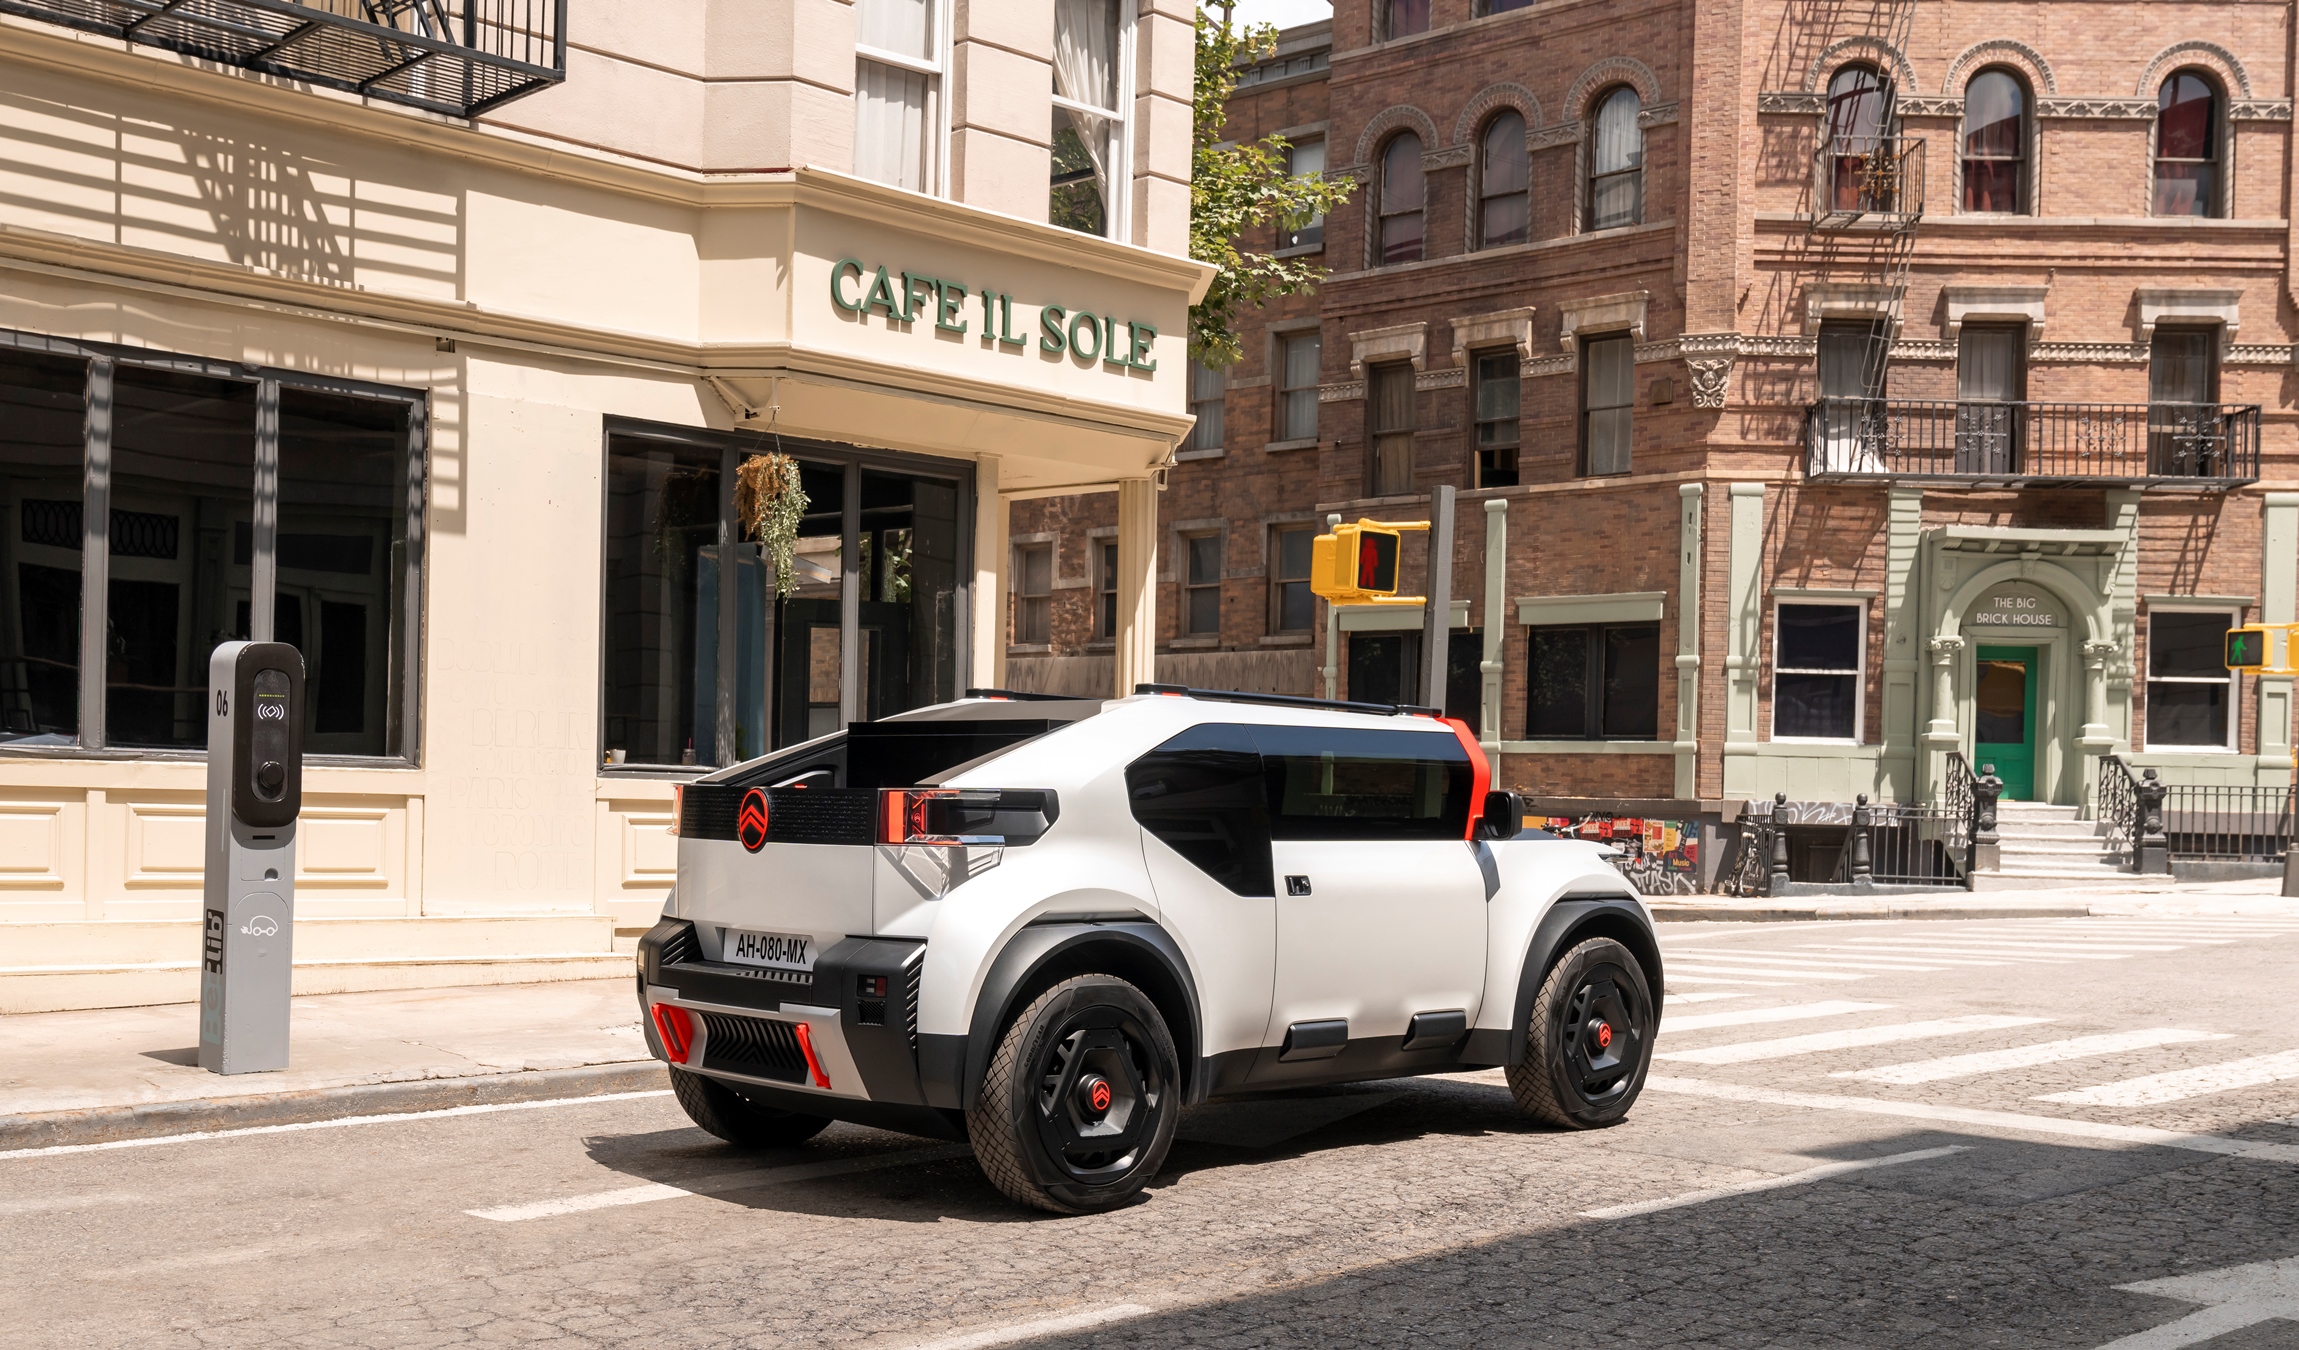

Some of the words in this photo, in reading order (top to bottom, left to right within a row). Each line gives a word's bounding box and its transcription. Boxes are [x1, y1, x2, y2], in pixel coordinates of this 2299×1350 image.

[831, 257, 968, 333] CAFE
[981, 290, 1027, 346] IL
[1040, 303, 1158, 372] SOLE
[1976, 612, 2008, 625] BRICK
[2013, 614, 2052, 625] HOUSE
[1994, 597, 2013, 608] THE
[2016, 597, 2036, 608] BIG
[216, 689, 229, 718] 06
[472, 708, 591, 751] BERLIN
[449, 776, 533, 810] PARIS
[468, 813, 587, 847] TORONTO
[494, 850, 587, 891] ROME
[1672, 858, 1690, 867] Music
[736, 933, 808, 965] AH-080-MX
[1023, 1024, 1045, 1068] GOODYEAR
